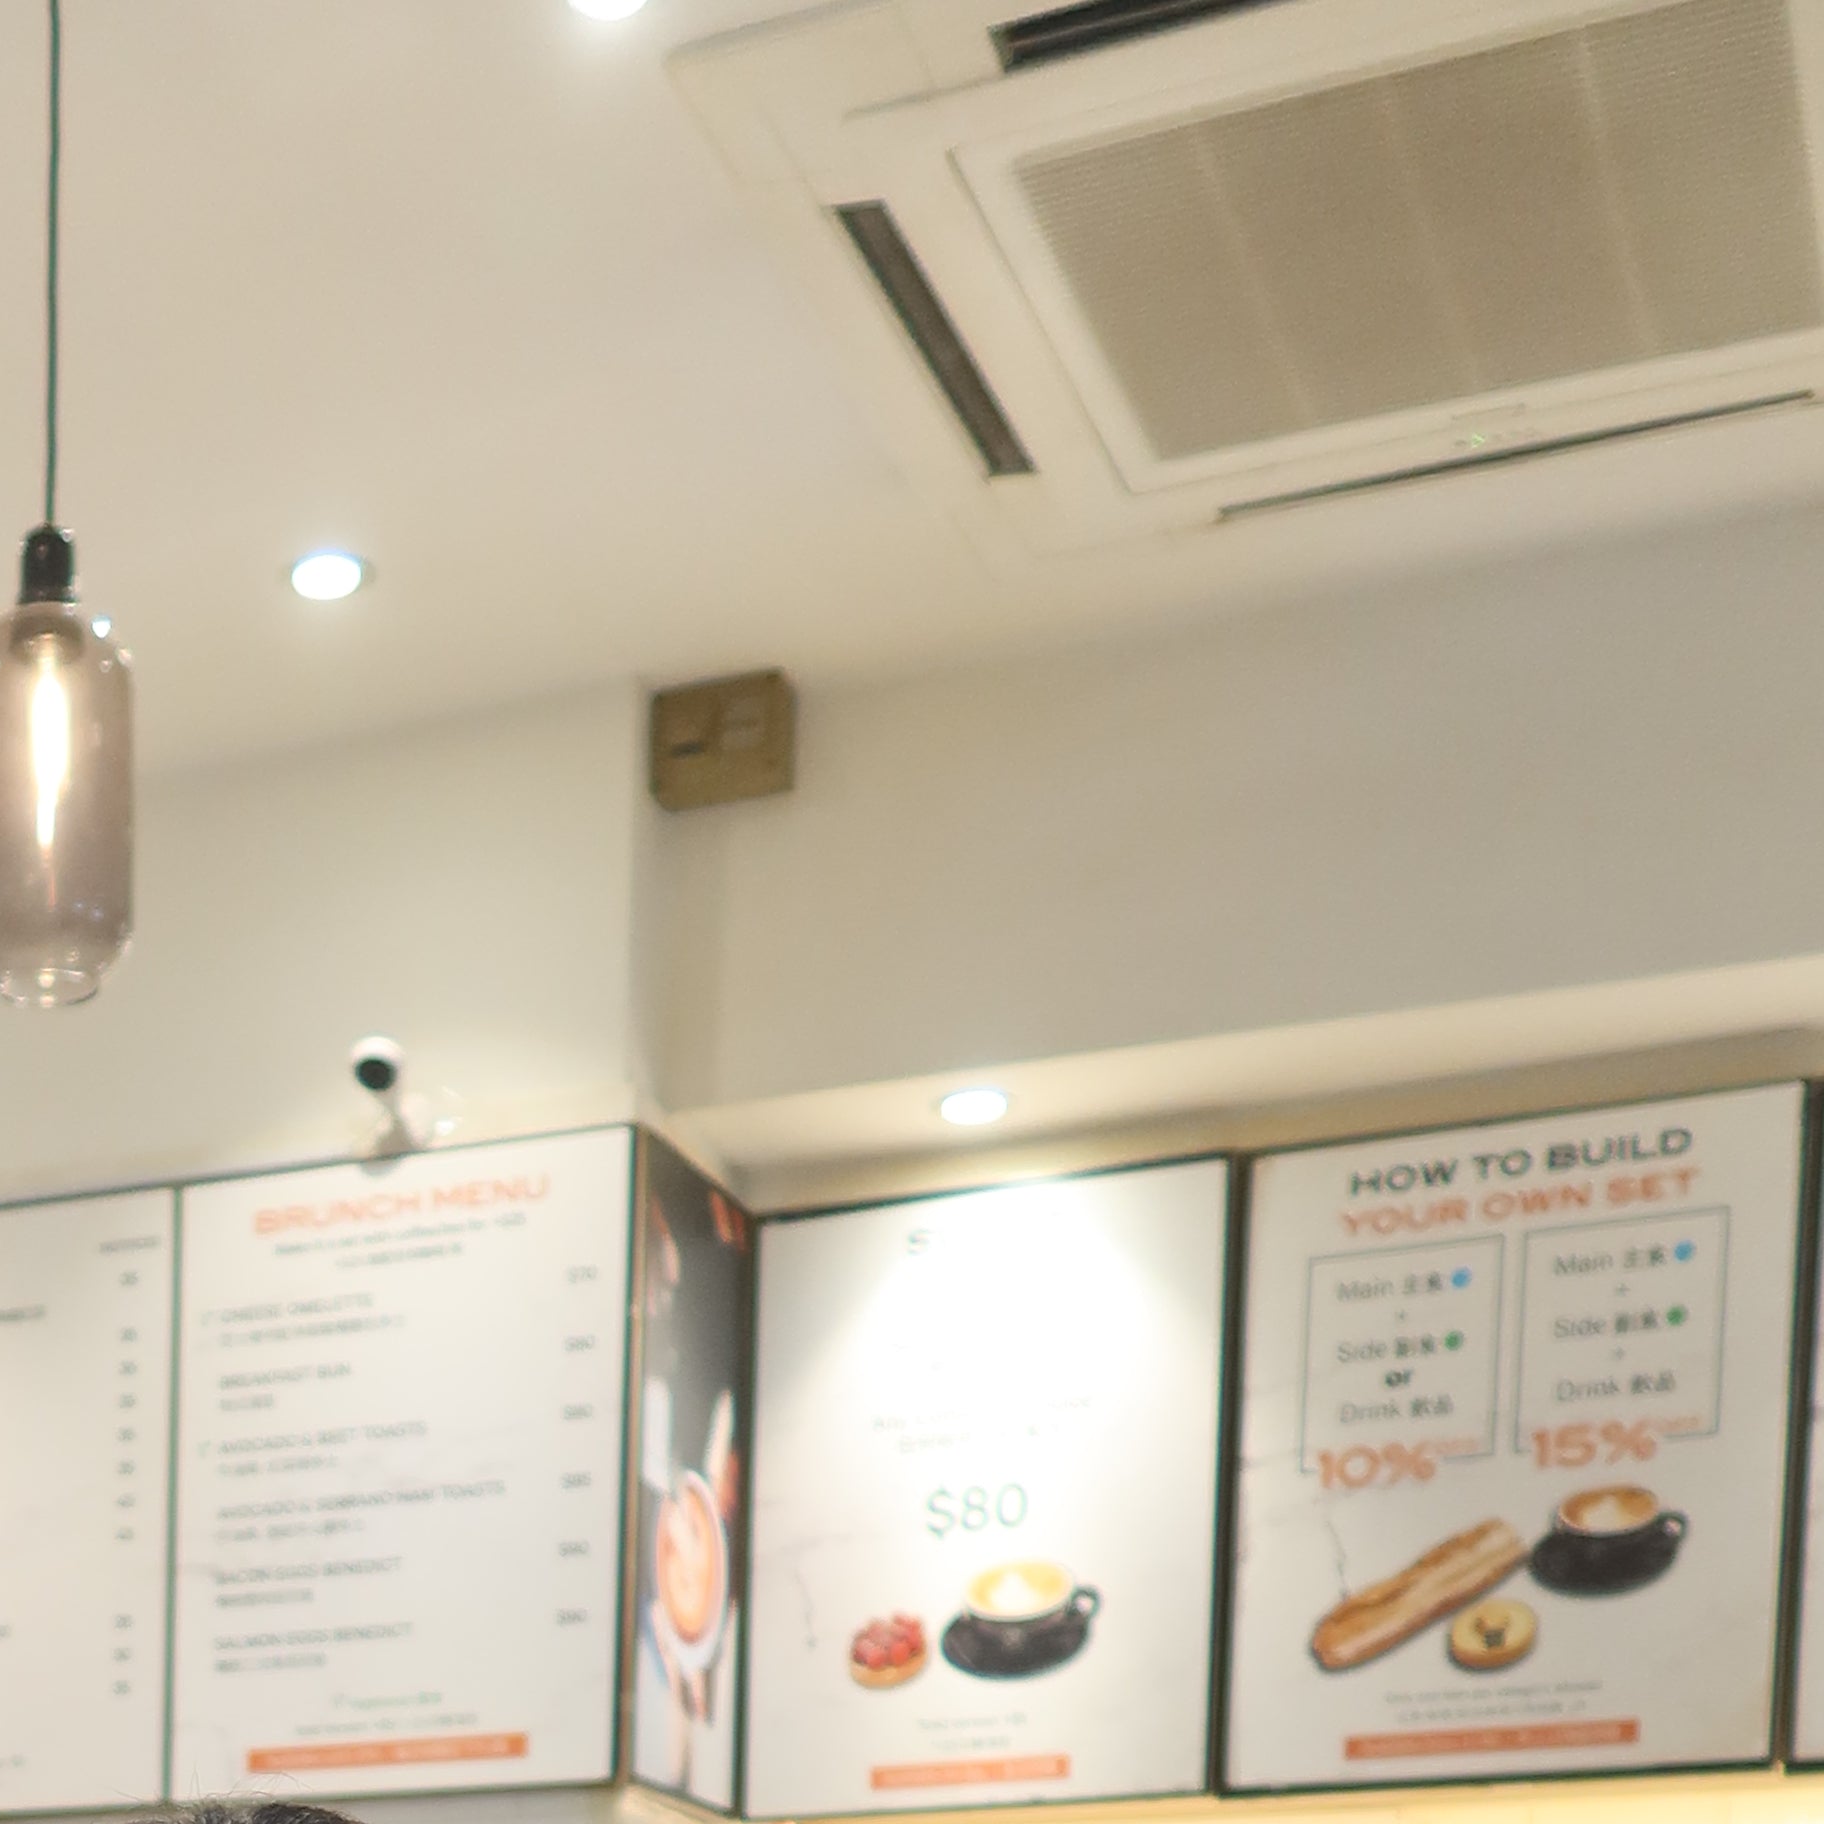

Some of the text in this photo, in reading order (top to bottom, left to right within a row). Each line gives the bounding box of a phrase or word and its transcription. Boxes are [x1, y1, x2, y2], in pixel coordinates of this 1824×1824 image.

[1350, 1128, 1693, 1196] HOW TO BUILD
[253, 1174, 550, 1236] BRUNCH MENU
[1341, 1166, 1699, 1235] YOUR OWN SET
[1384, 1369, 1414, 1388] or
[1317, 1441, 1437, 1490] 10%
[1532, 1419, 1658, 1470] 15%
[925, 1482, 1029, 1540] $80
